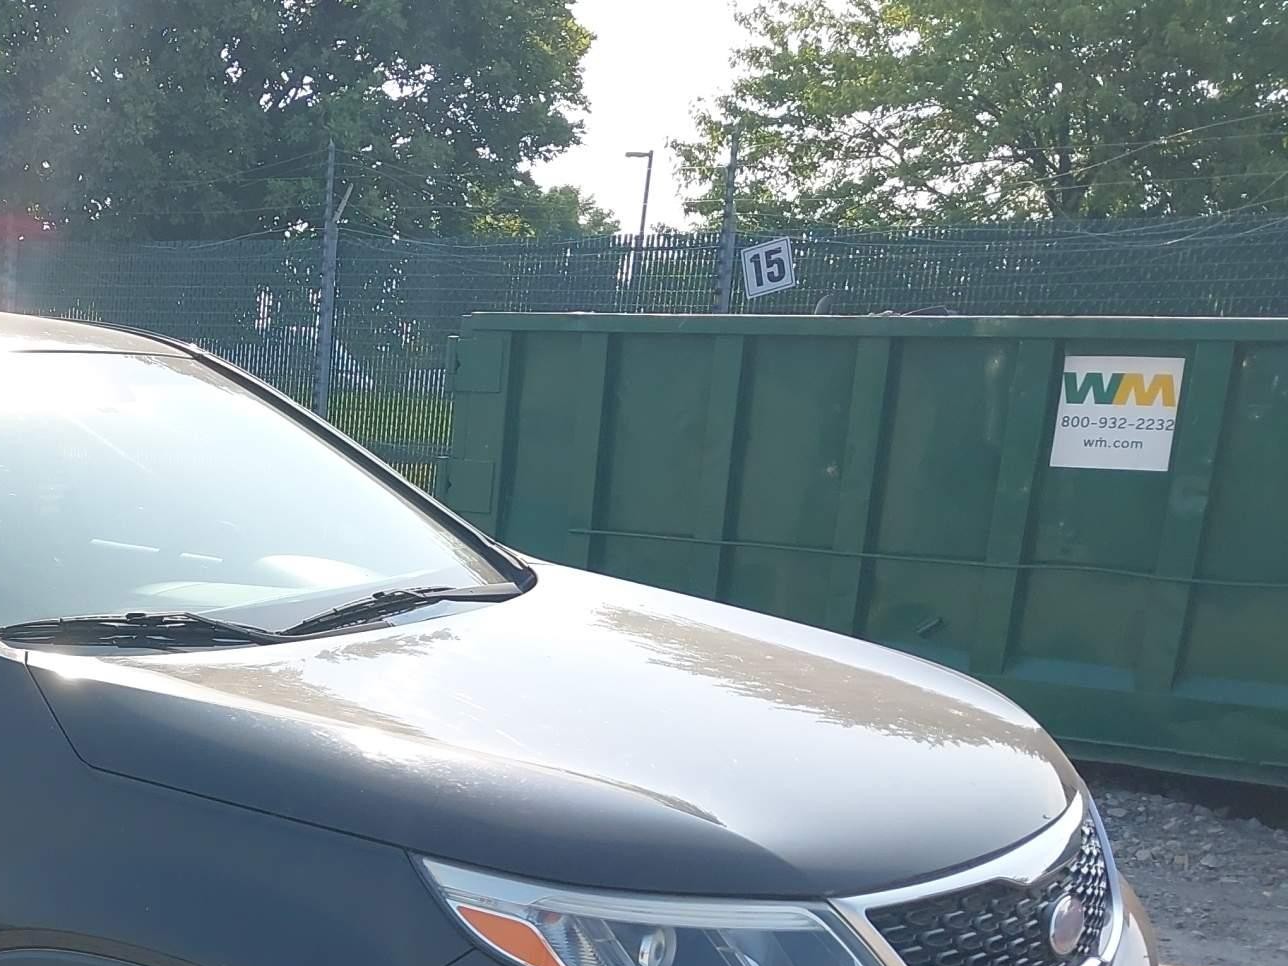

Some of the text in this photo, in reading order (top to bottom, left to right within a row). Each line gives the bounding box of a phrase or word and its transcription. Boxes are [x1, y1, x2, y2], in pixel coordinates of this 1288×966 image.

[750, 247, 786, 287] 15
[1063, 372, 1176, 407] WM
[1062, 416, 1175, 431] 800-932-2232
[1083, 437, 1143, 449] wm.com
